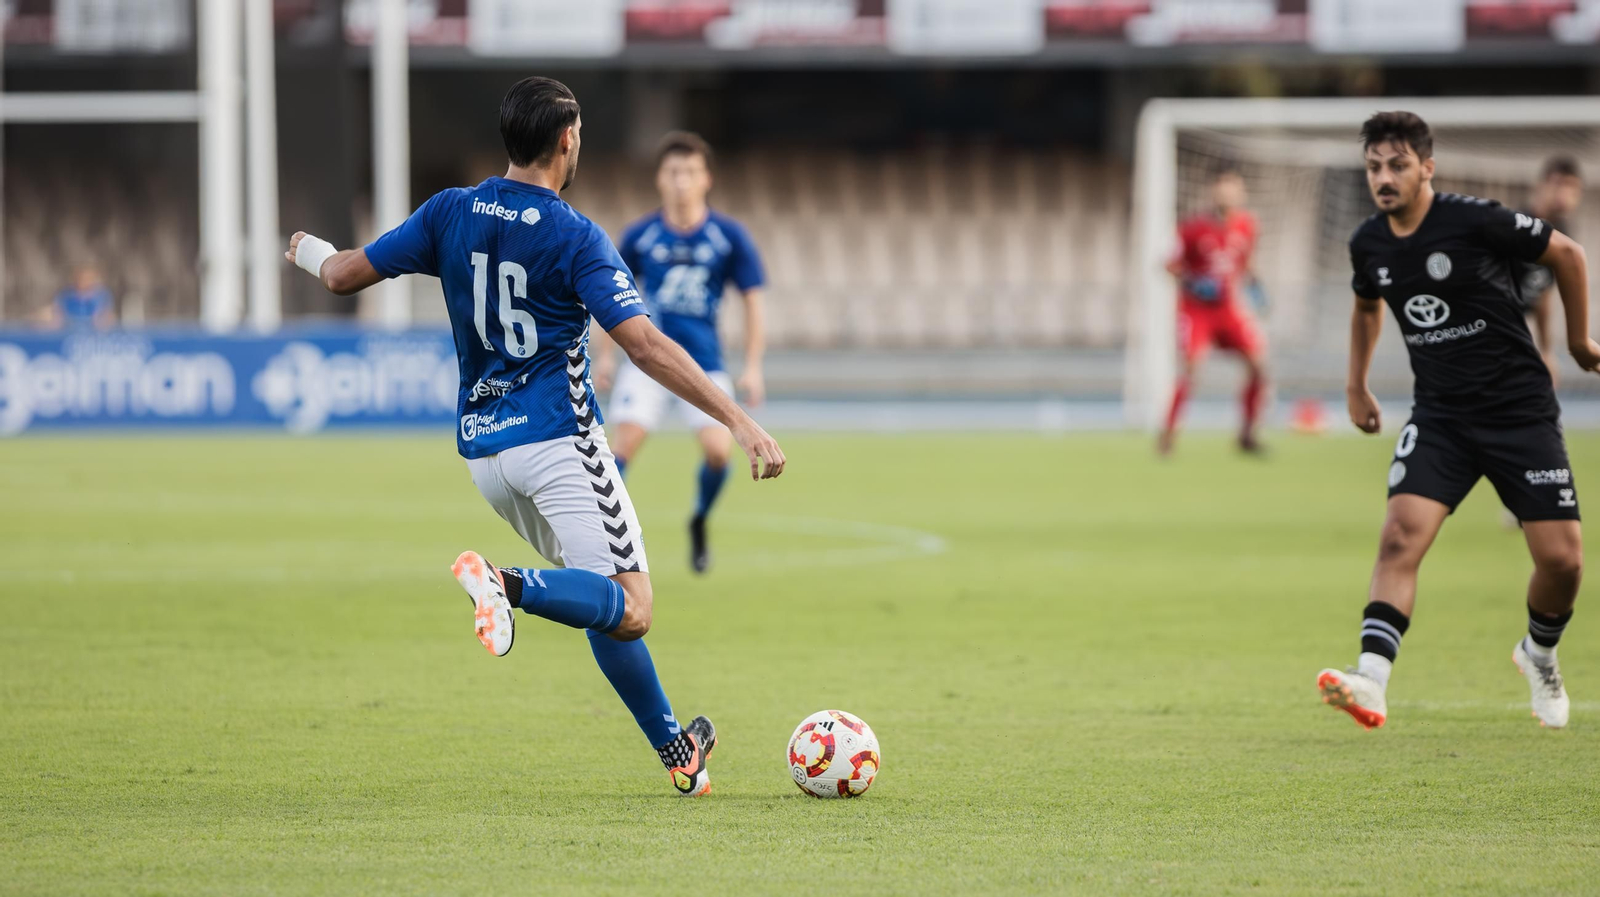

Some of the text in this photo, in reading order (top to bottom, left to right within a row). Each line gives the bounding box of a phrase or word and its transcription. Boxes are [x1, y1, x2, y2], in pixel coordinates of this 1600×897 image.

[472, 197, 518, 221] indeso
[471, 251, 538, 358] 16
[613, 289, 639, 302] SUZU
[1424, 318, 1487, 344] GORDILLO
[477, 410, 497, 425] Hig
